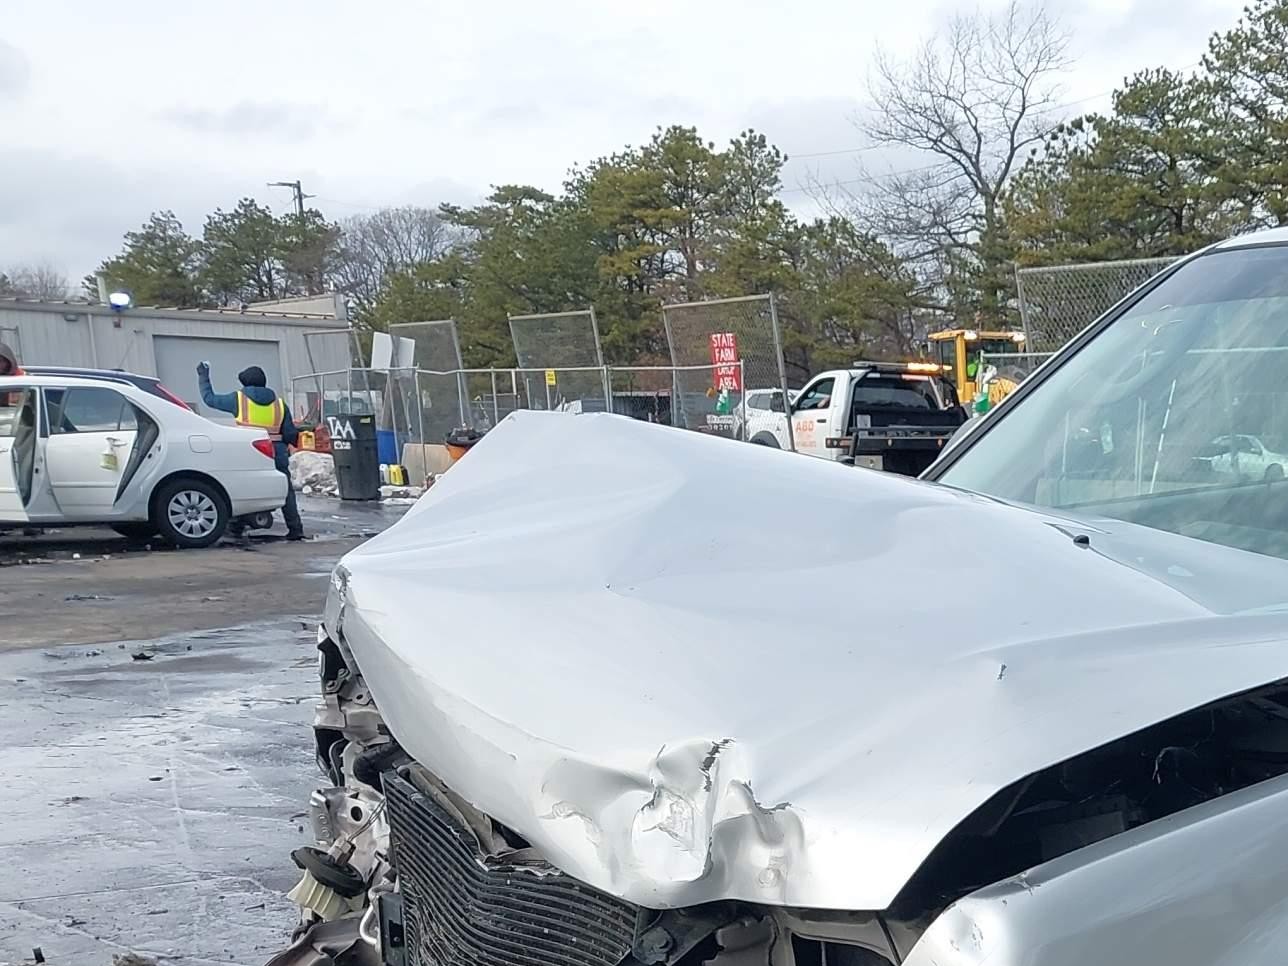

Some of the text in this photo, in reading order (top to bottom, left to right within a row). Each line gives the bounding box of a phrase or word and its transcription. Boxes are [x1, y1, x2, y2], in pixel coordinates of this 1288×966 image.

[711, 333, 734, 347] STATE
[714, 348, 735, 362] FARM
[718, 377, 738, 390] AREA
[327, 416, 357, 440] IAA
